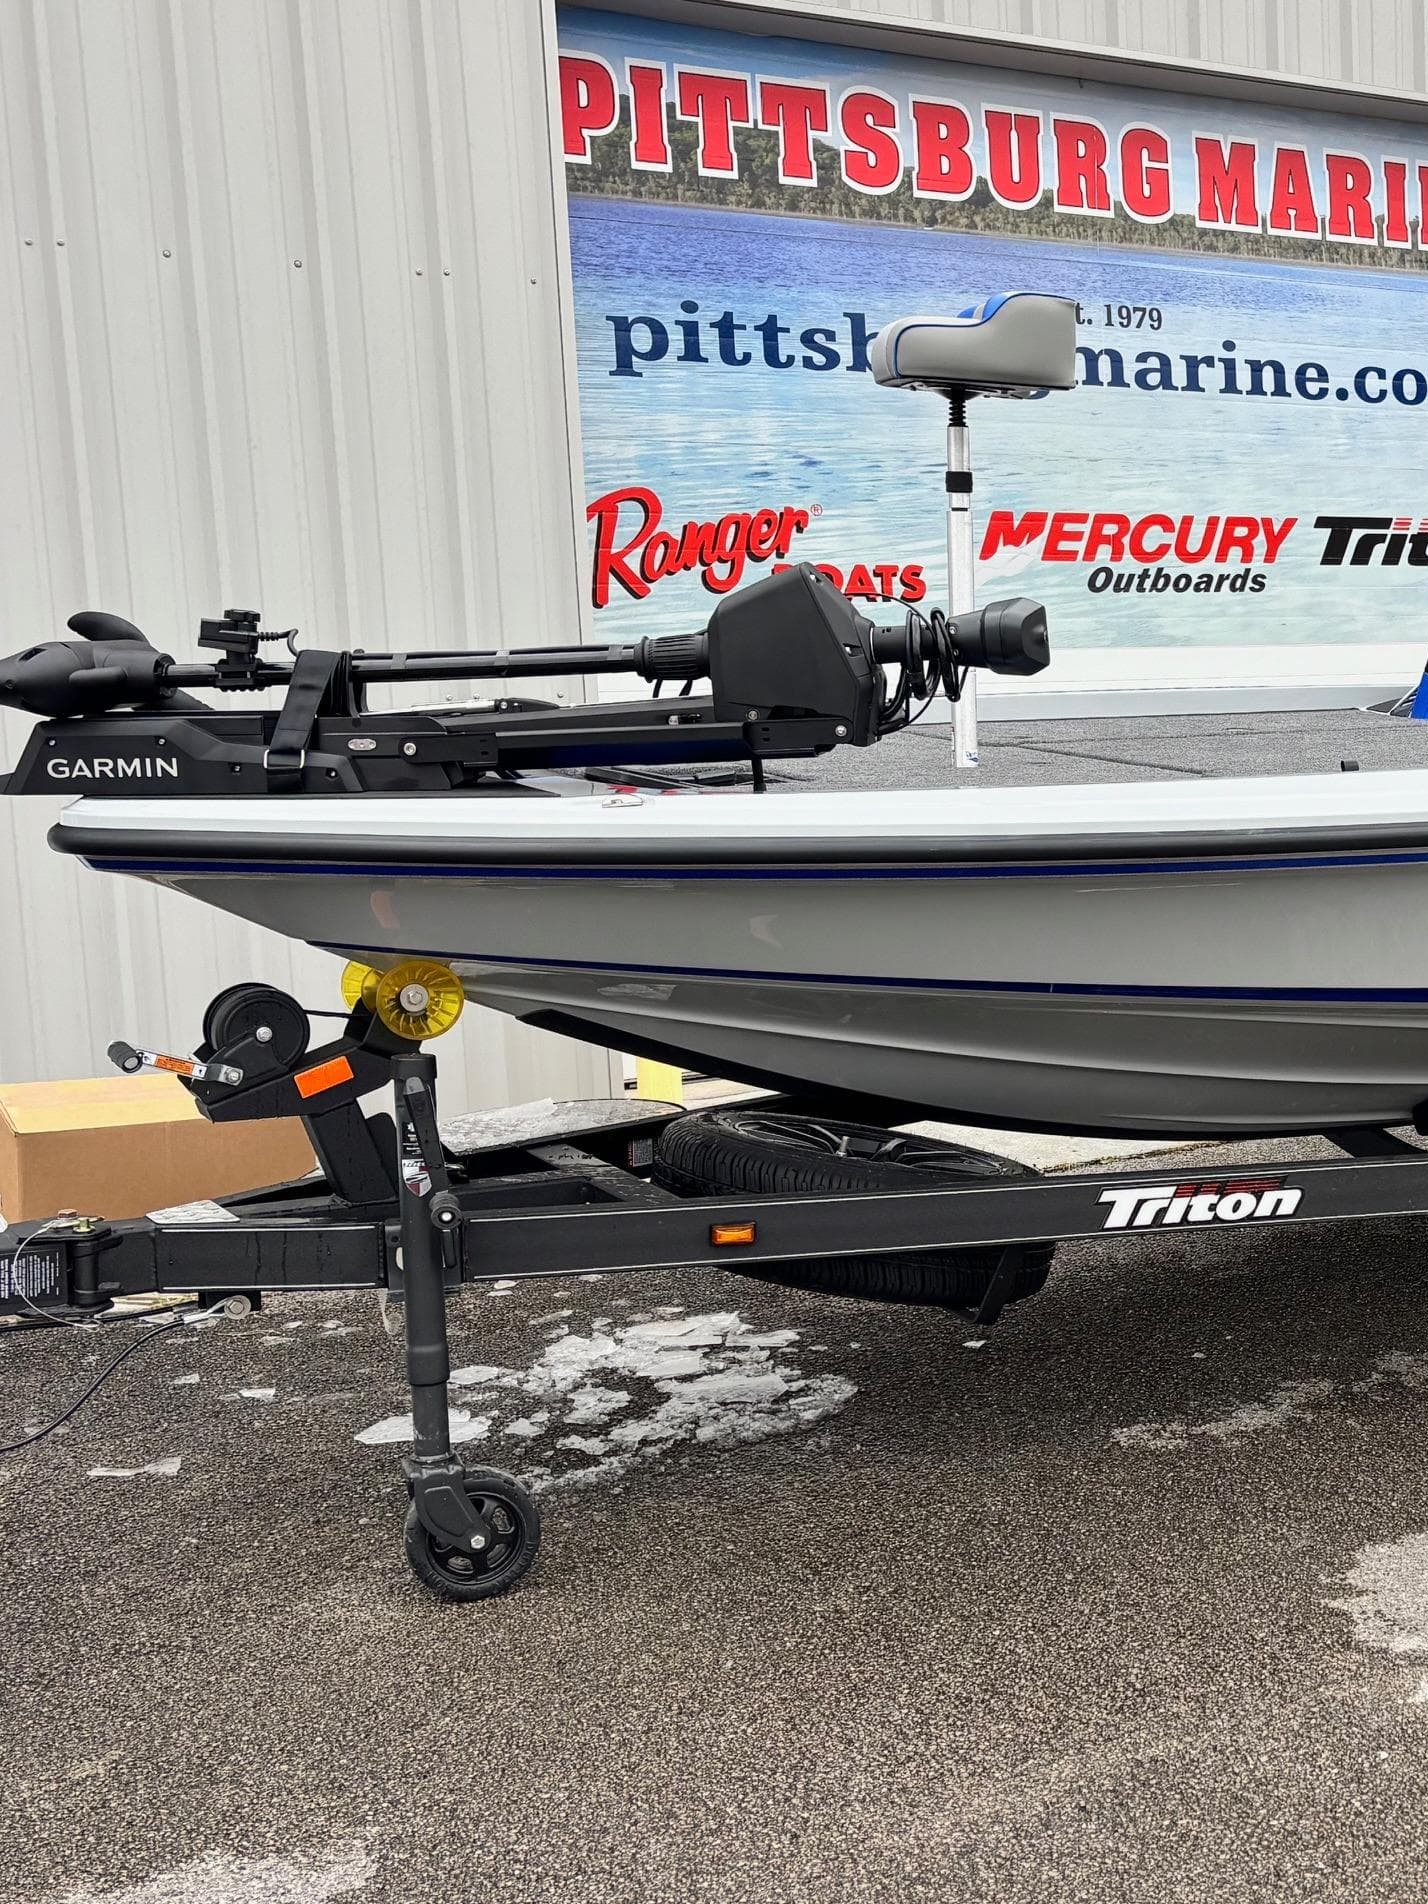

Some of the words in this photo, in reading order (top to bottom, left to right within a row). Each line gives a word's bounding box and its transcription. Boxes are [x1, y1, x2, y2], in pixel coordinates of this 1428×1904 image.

[558, 51, 1172, 223] PITTSBURG
[1104, 303, 1163, 331] 1979
[586, 487, 809, 608] Ranger
[979, 511, 1298, 564] MERCURY
[1087, 566, 1267, 594] Outboards
[47, 757, 179, 780] GARMIN
[1098, 1178, 1303, 1229] Triton
